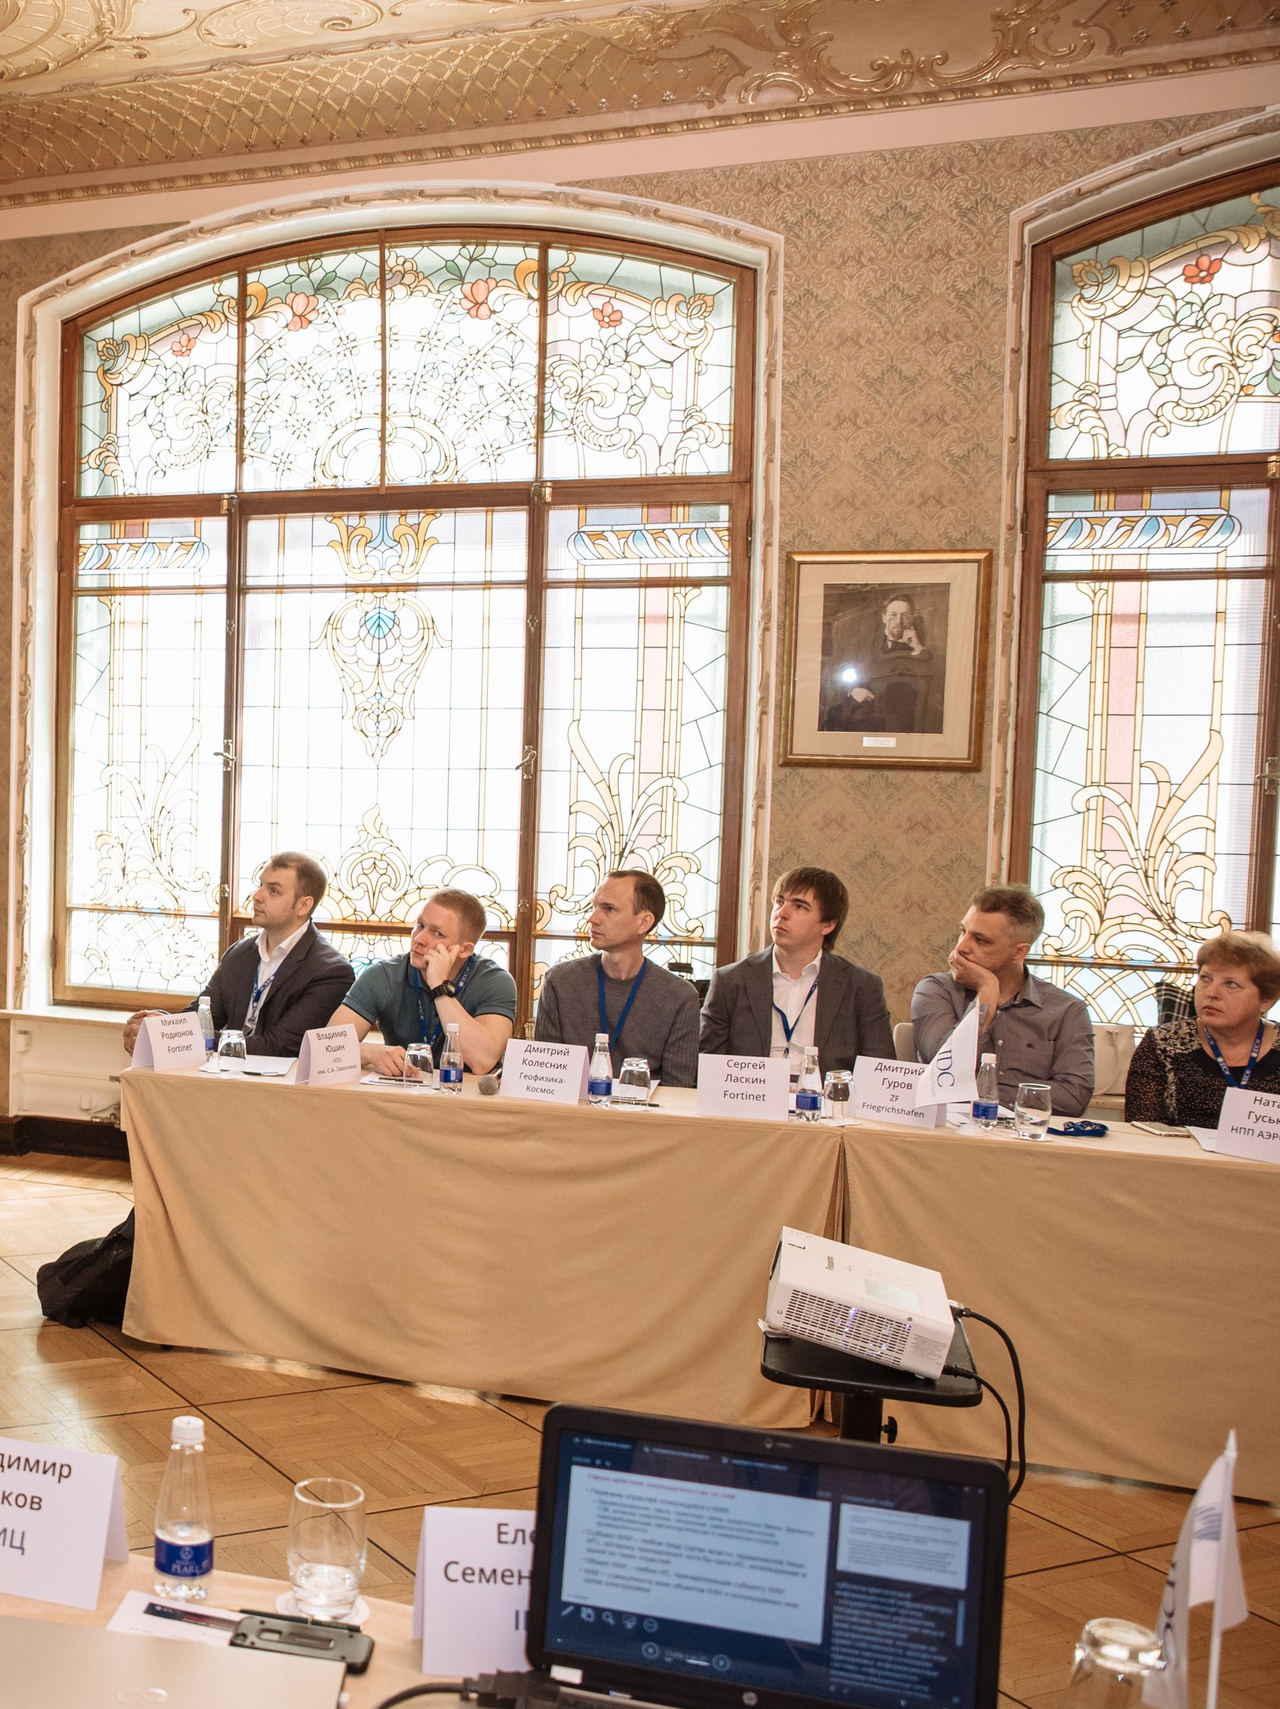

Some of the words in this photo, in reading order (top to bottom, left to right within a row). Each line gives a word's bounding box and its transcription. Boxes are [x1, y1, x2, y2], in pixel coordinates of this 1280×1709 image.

[160, 1018, 187, 1026] Михаил
[161, 1030, 194, 1040] Родионов
[316, 1030, 347, 1041] Владимир
[167, 1044, 193, 1053] Fortinet
[325, 1044, 345, 1053] Юшин
[524, 1044, 570, 1056] Дмитрий
[522, 1058, 568, 1070] Колесник
[727, 1059, 765, 1071] Сергей
[519, 1072, 566, 1084] Геофизика-
[724, 1074, 766, 1085] Ласкин
[882, 1077, 913, 1090] Гуров
[526, 1085, 555, 1095] Космос
[723, 1090, 766, 1102] Fortinet
[889, 1094, 900, 1102] ZF
[1231, 1125, 1255, 1137] НПП
